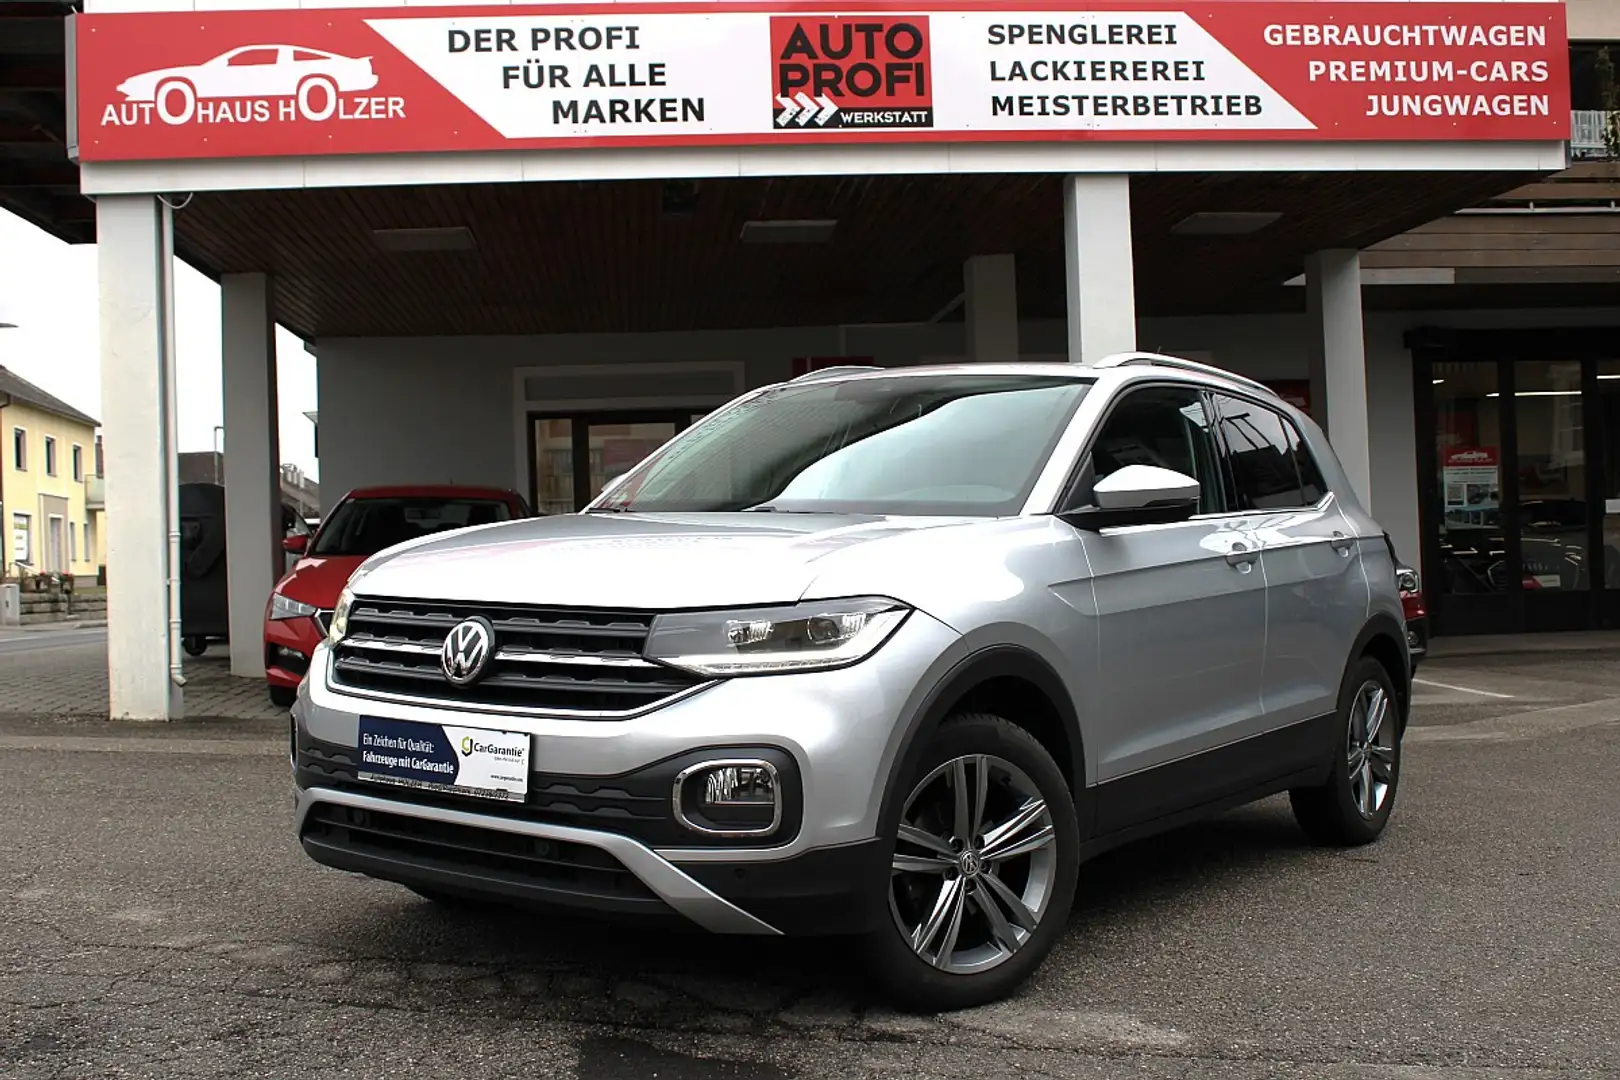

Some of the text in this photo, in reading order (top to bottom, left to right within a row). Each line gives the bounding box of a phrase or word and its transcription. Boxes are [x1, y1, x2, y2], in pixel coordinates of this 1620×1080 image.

[448, 26, 640, 53] DER PROFI
[780, 23, 923, 60] AUTO
[988, 24, 1177, 45] SPENGLEREI
[1263, 24, 1545, 46] GEBRAUCHTWAGEN
[503, 58, 666, 89] FÜR ALLE
[779, 62, 925, 97] PROFI
[990, 60, 1206, 81] LACKIEREREI
[1308, 60, 1549, 82] PREMIUM-CARS
[100, 76, 406, 126] AUTOHAUS HOLZER
[552, 98, 705, 124] MARKEN
[992, 95, 1263, 116] MEISTERBETRIEB
[1366, 95, 1549, 116] JUNGWAGEN
[840, 111, 928, 123] WERKSTATT
[363, 733, 373, 746] Ein
[373, 734, 397, 749] Zeichen
[397, 737, 407, 750] für
[362, 750, 454, 774] Fahrzeuge mit CarGarantie
